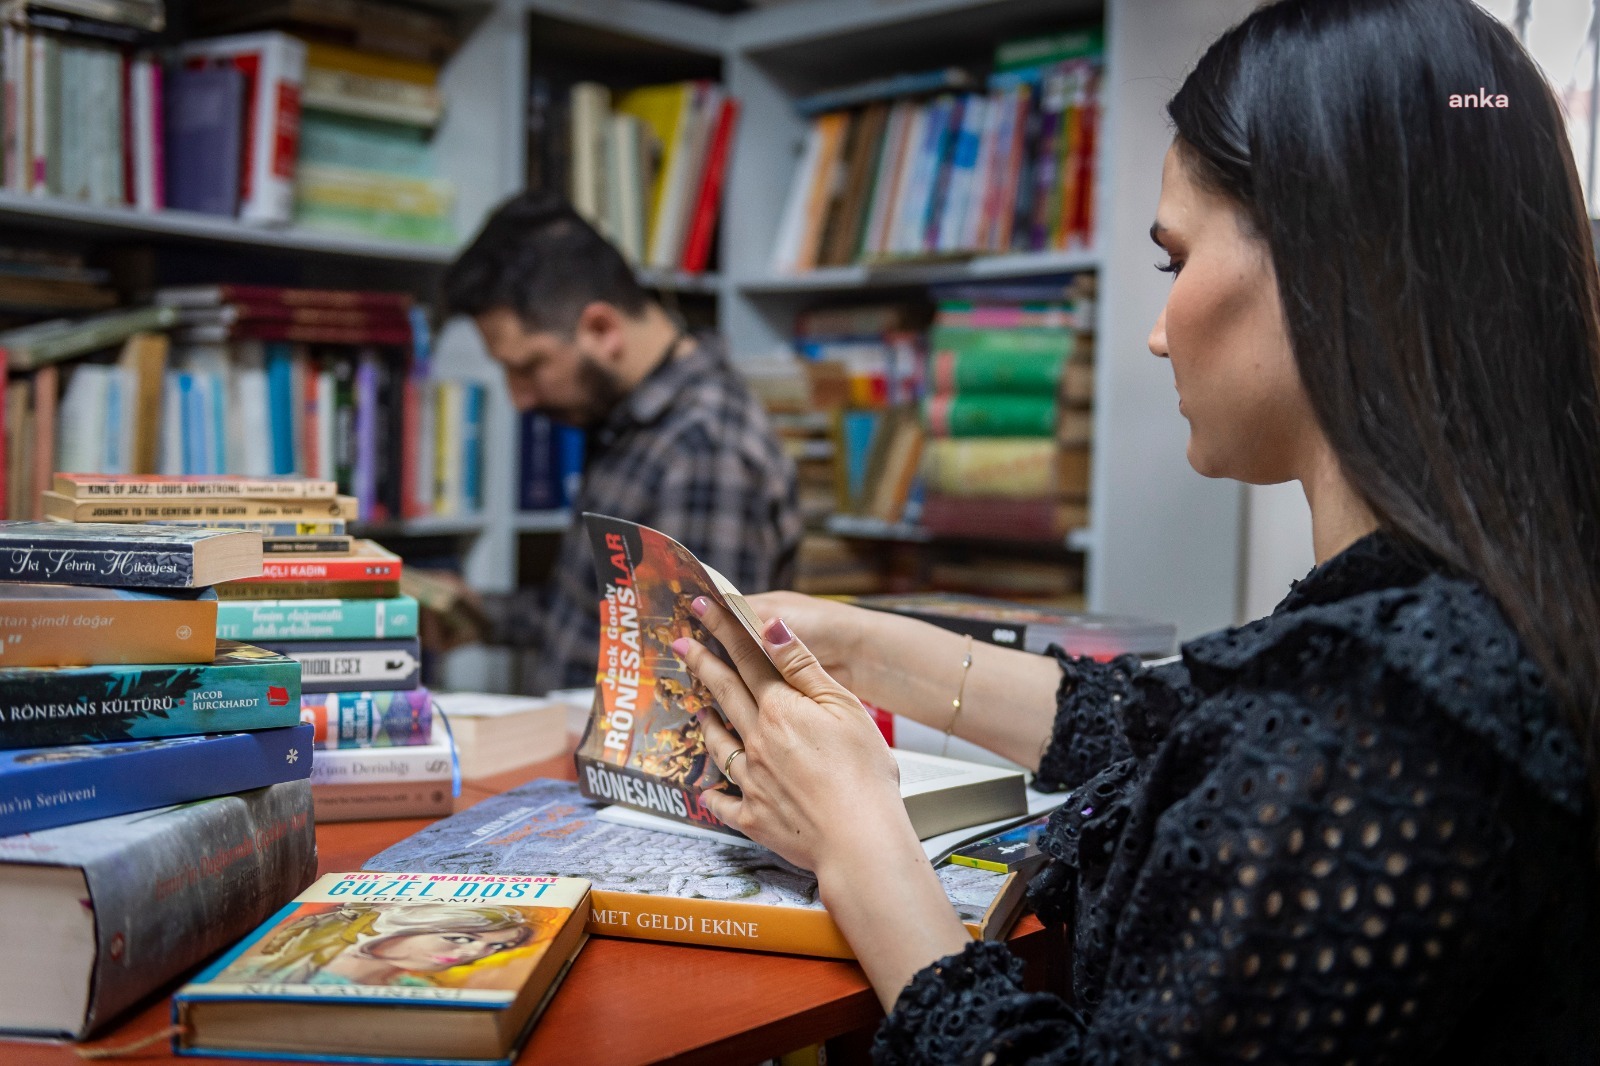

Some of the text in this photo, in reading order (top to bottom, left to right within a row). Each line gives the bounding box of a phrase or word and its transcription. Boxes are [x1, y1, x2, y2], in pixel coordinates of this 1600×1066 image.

[88, 484, 110, 495] KING
[114, 484, 125, 495] OF
[156, 484, 183, 494] LOUIS
[186, 483, 240, 494] ARMSTRONG
[92, 507, 129, 517] JOURNEY
[132, 507, 142, 516] TO
[145, 507, 159, 516] THE
[161, 507, 192, 516] CENTRE
[193, 506, 203, 516] OF
[205, 506, 220, 516] THE
[222, 506, 247, 515] EARTH
[10, 545, 178, 578] İki Şehrin Hikâyesi
[290, 565, 327, 577] KADIN
[31, 614, 70, 630] şimdi
[73, 614, 115, 629] doğar
[604, 583, 619, 691] Jack Goody
[301, 658, 361, 676] MIDDLESEX
[192, 690, 223, 702] JACOB
[192, 698, 259, 711] BURCKHARDT
[11, 701, 97, 721] RÖNESANS
[102, 696, 173, 715] KÜLTÜRÜ
[36, 784, 97, 809] Serüveni
[429, 875, 560, 884] MAUPASSANT
[328, 880, 557, 899] GÜZEL DOST
[587, 908, 759, 938] MET GELDİ EKİNE
